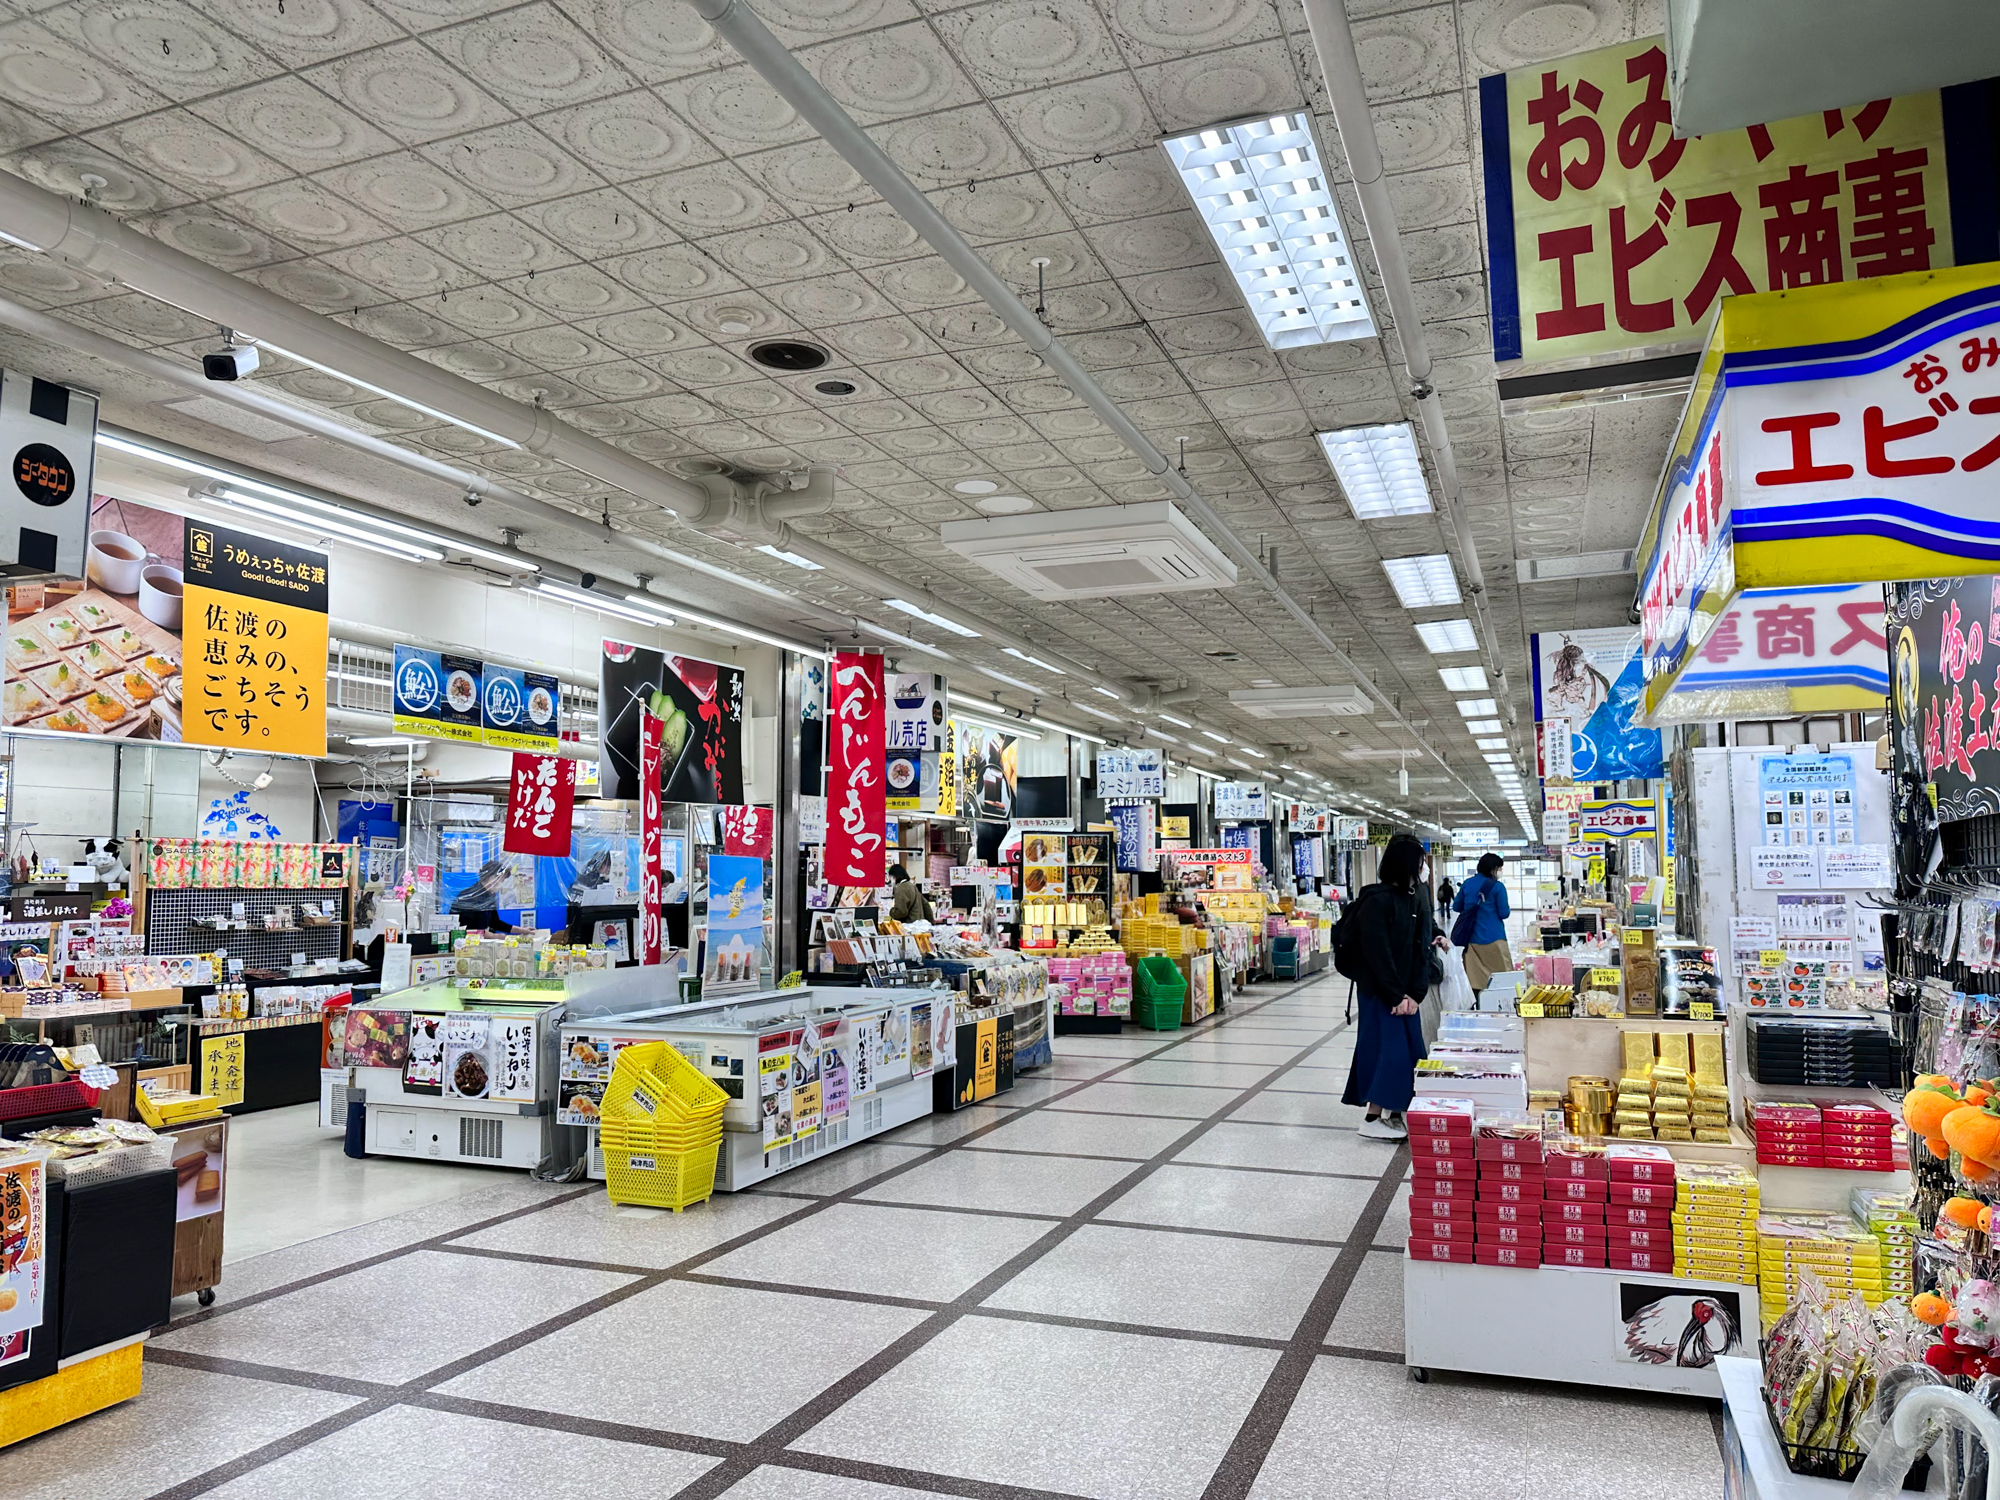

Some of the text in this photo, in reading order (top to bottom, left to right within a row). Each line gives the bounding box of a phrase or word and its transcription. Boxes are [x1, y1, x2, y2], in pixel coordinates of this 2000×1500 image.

[1526, 43, 1893, 202] おみ
[1535, 147, 1936, 340] エビス商事
[21, 456, 68, 496] シータウン
[223, 543, 326, 585] うめぇっちゃ佐渡
[241, 570, 310, 593] Good! Good! SADO
[205, 604, 287, 640] 佐渡の
[1939, 598, 1984, 686] 俺の
[203, 637, 299, 675] 恵みの、
[203, 672, 310, 713] ごちそう
[203, 706, 271, 738] です。
[836, 665, 882, 878] へんじんもっこ
[1099, 778, 1160, 795] ターミナル売店
[219, 807, 250, 822] Ryotsu
[513, 769, 534, 828] いけだ
[532, 754, 560, 838] だんご
[1216, 804, 1263, 817] ターミナル売店
[1122, 809, 1139, 869] 佐渡の酒
[1233, 830, 1246, 849] 佐
[1587, 815, 1648, 826] エビス商事
[1301, 840, 1312, 875] 佐渡の酒
[224, 1037, 241, 1091] 地方発送
[506, 1026, 519, 1091] いごねり
[631, 1159, 655, 1169] 両津売店
[5, 1172, 21, 1220] 佐渡の
